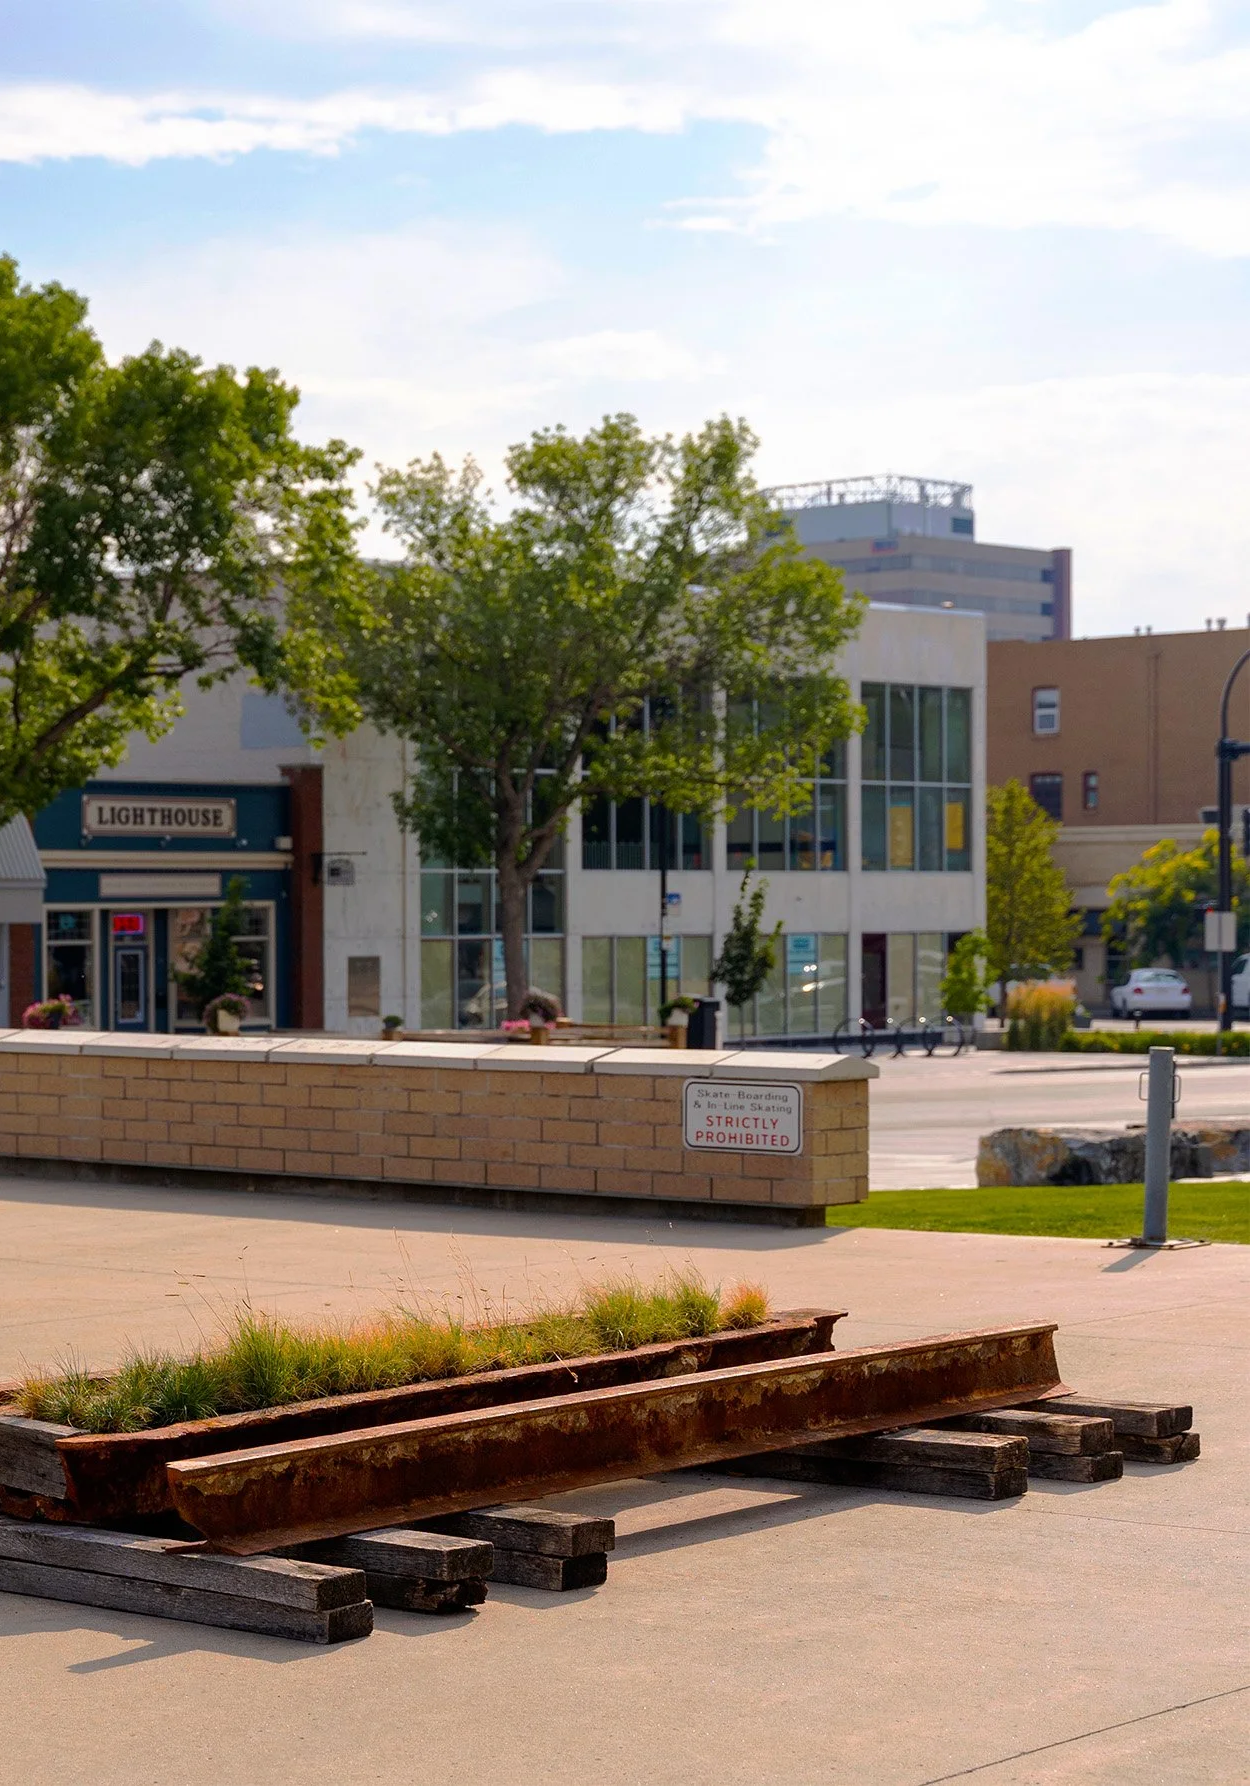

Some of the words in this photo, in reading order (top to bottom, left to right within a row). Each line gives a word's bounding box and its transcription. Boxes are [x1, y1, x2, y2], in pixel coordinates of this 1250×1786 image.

[97, 806, 224, 827] LIGHTHOUSE
[697, 1088, 788, 1103] Skate-Boarding
[693, 1100, 702, 1109] &
[707, 1101, 745, 1111] In-Line
[750, 1103, 792, 1115] Skating
[706, 1115, 779, 1129] STRICTLY
[695, 1130, 790, 1147] PROHIBITED
